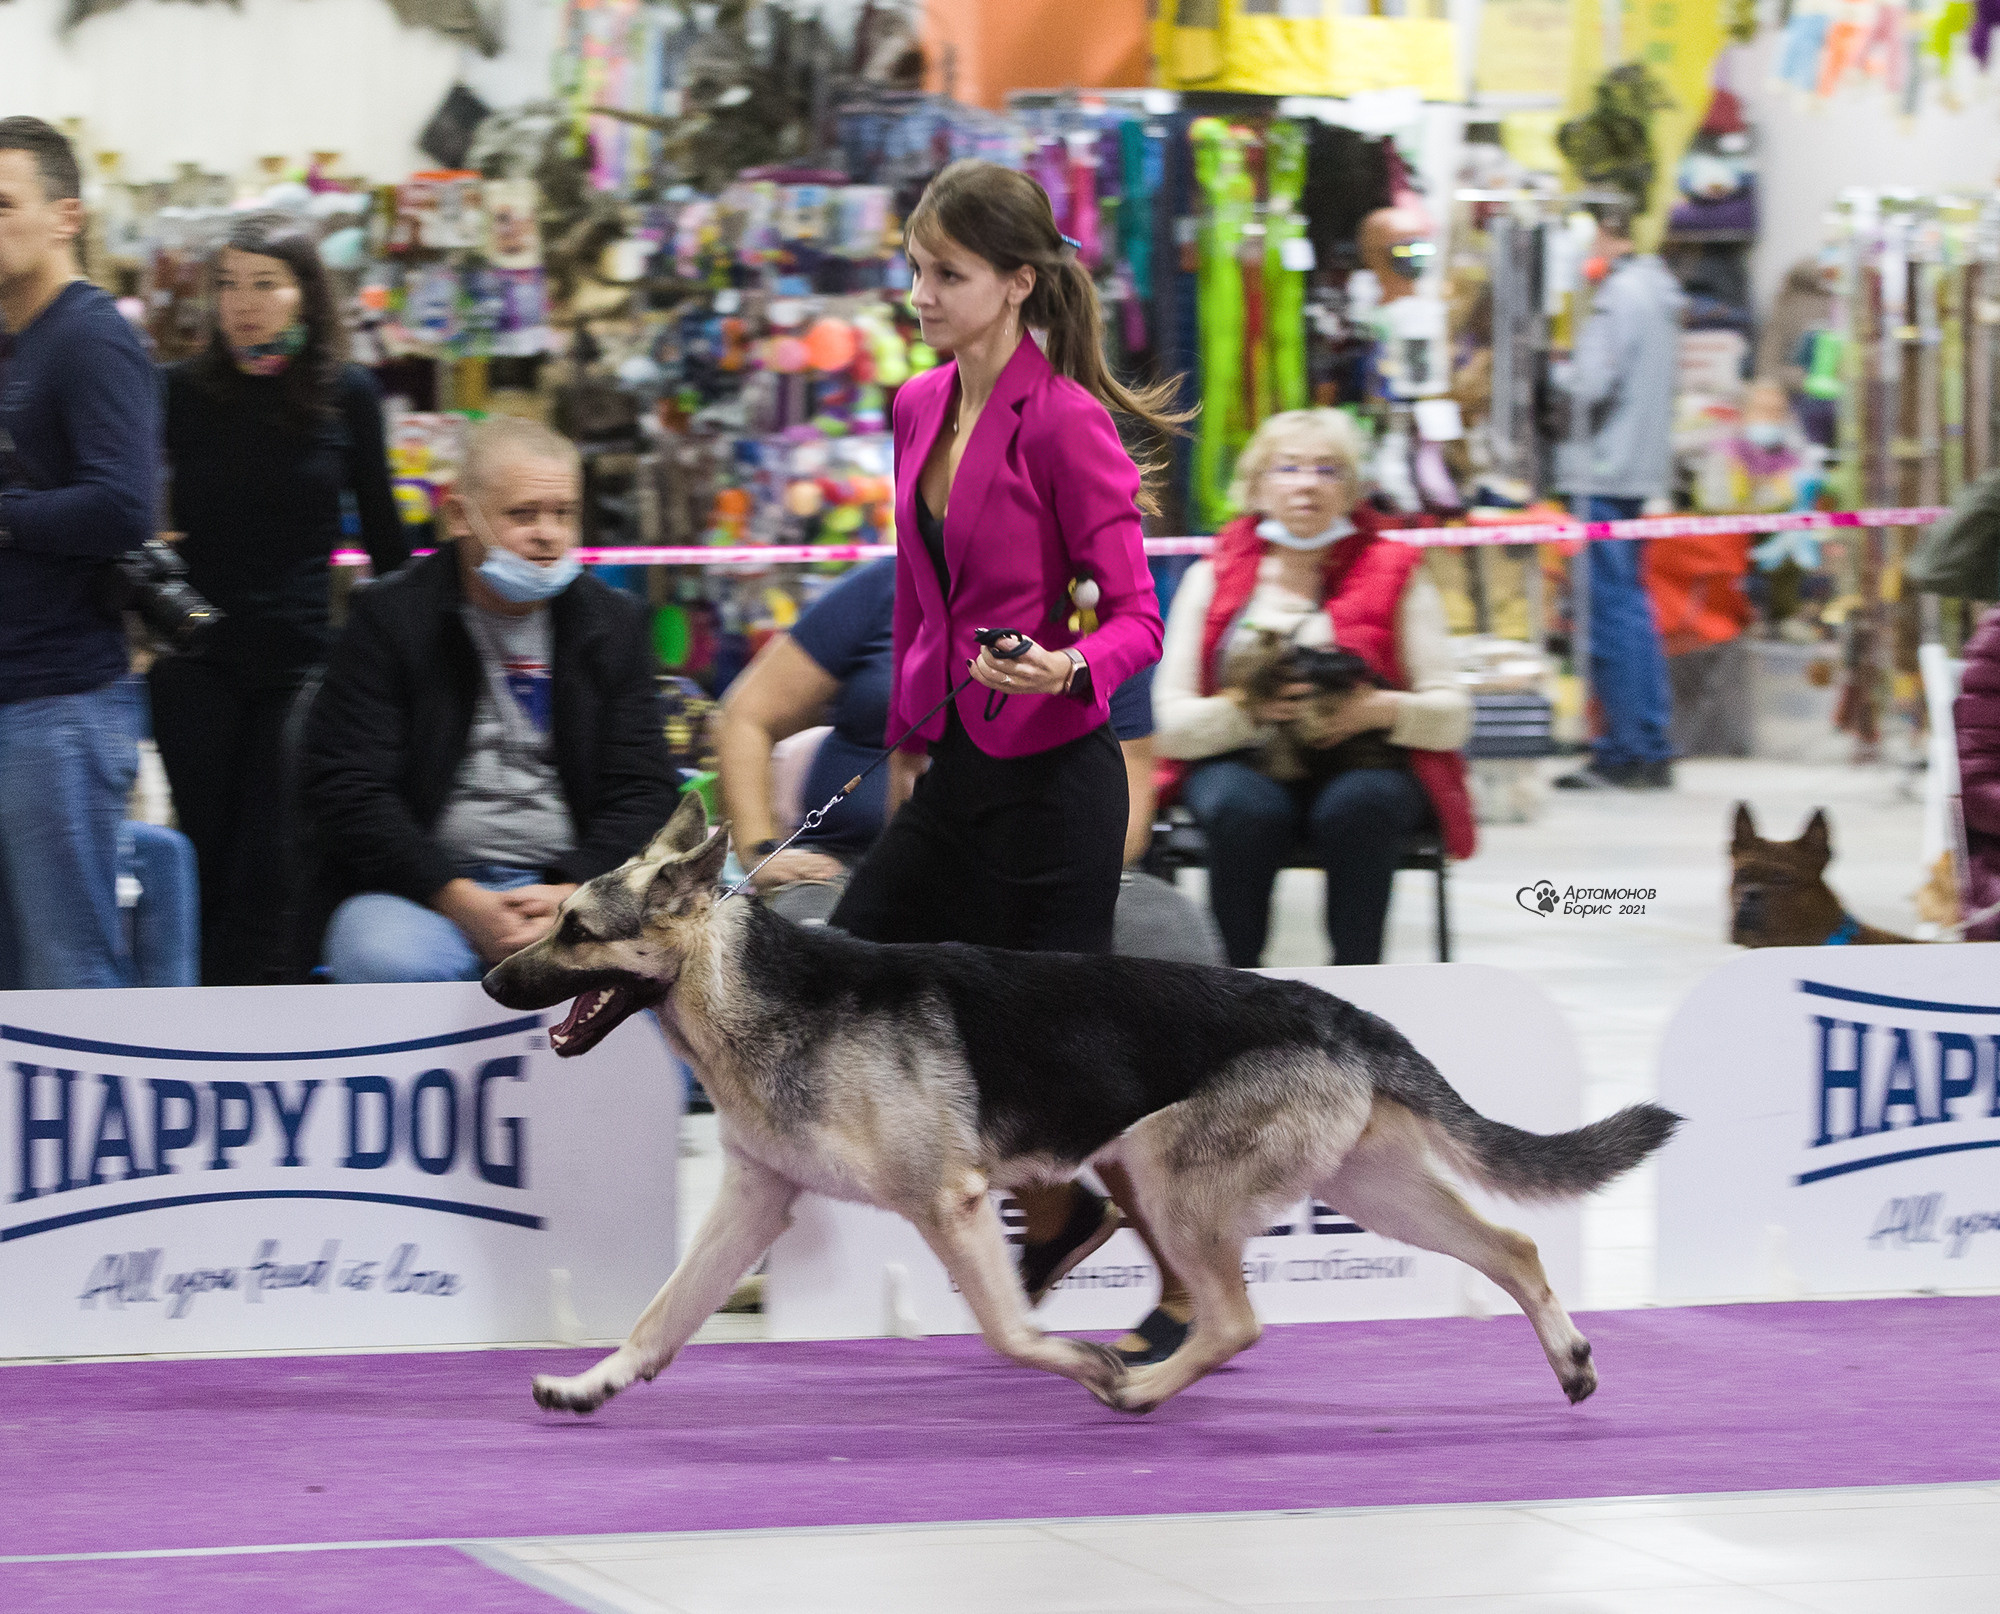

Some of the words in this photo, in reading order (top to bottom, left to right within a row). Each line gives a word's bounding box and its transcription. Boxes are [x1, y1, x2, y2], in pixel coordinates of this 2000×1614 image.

[8, 1060, 320, 1203] HAPPY
[337, 1055, 530, 1190] DOG
[1808, 1014, 2000, 1149] HAP
